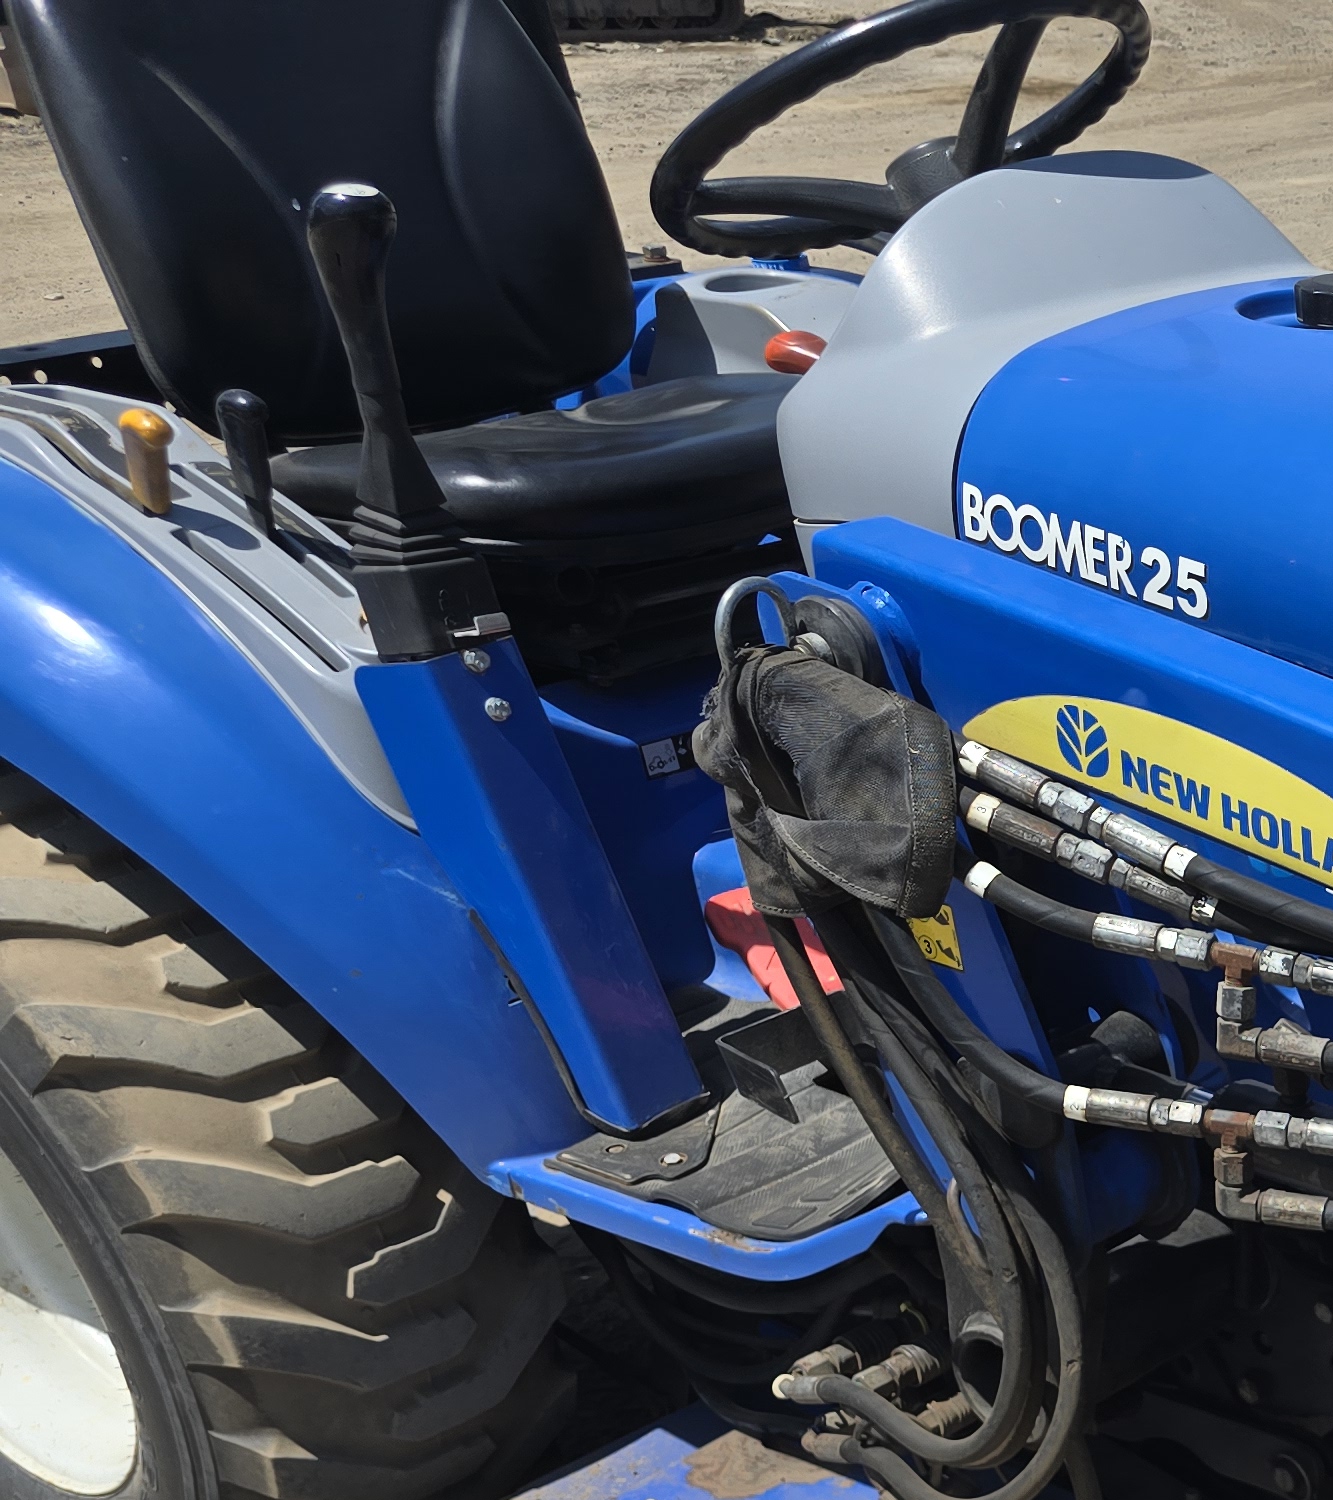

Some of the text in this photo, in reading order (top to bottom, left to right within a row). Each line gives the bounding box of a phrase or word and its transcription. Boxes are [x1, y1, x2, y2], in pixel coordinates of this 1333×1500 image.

[962, 481, 1209, 620] BOOMER 25
[1120, 749, 1211, 821] NEW
